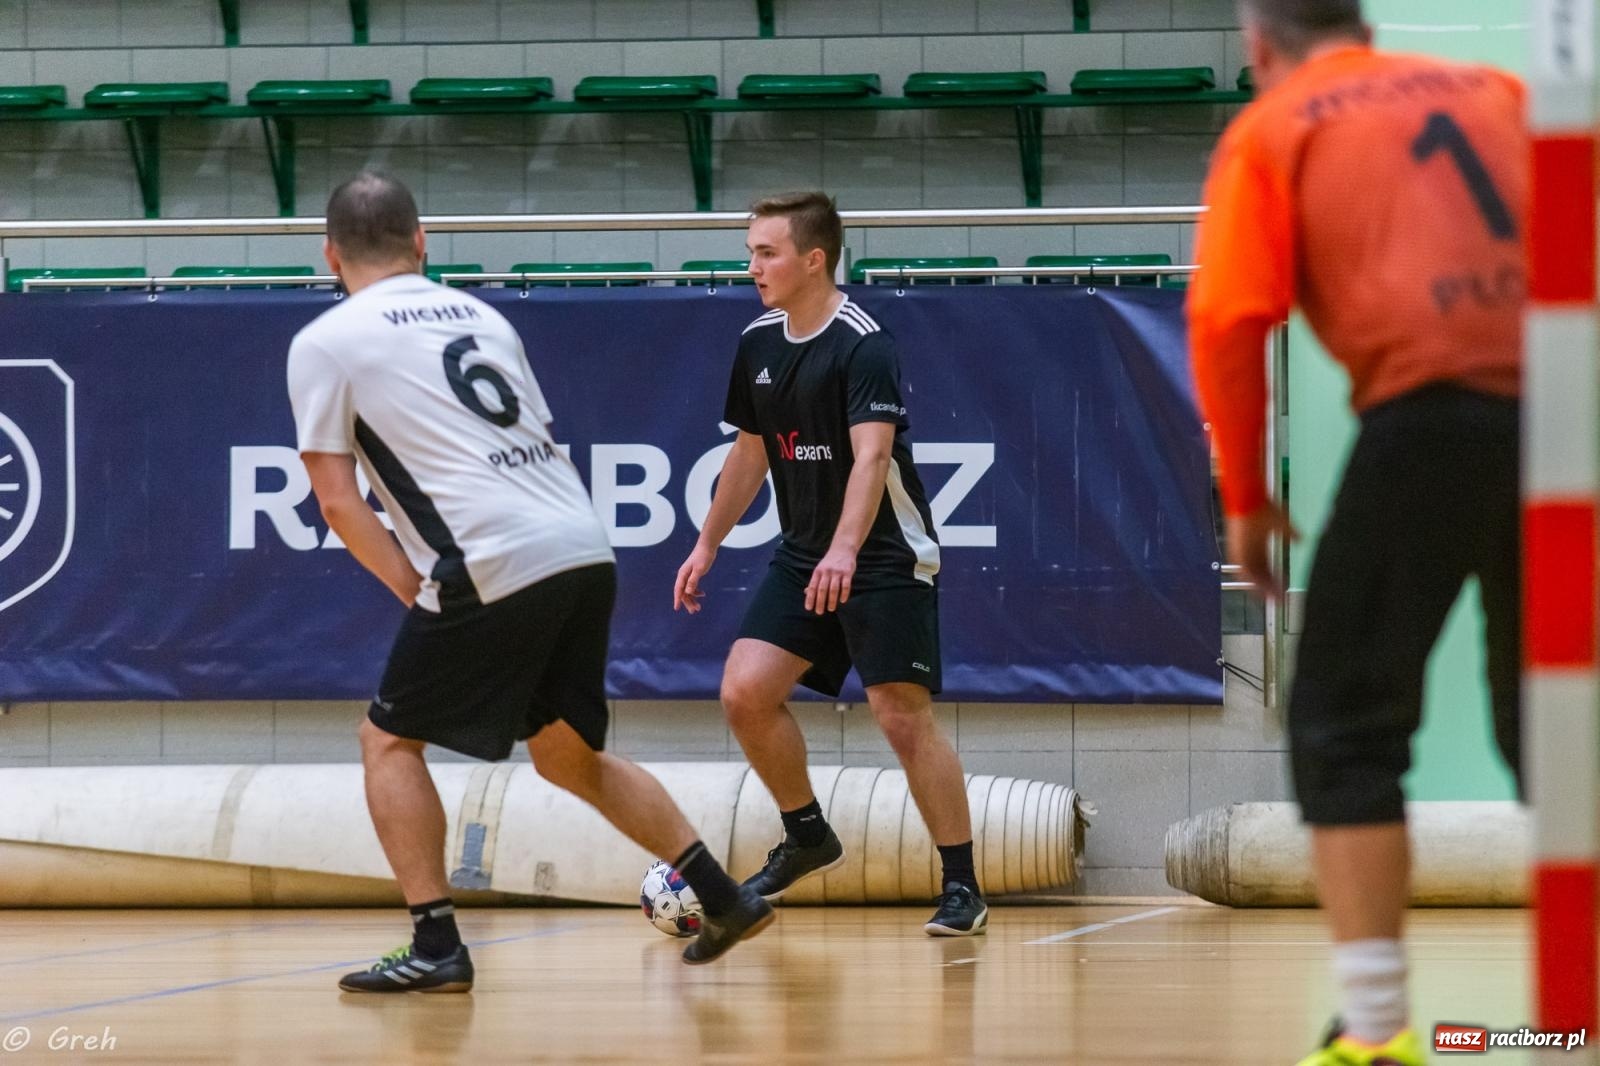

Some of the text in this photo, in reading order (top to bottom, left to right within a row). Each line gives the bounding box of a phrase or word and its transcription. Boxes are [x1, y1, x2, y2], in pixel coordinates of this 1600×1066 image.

[1411, 112, 1517, 241] 1
[382, 303, 482, 324] WICHER
[442, 335, 520, 428] 6
[229, 421, 997, 550] RBÓZ
[776, 430, 833, 461] Nexans
